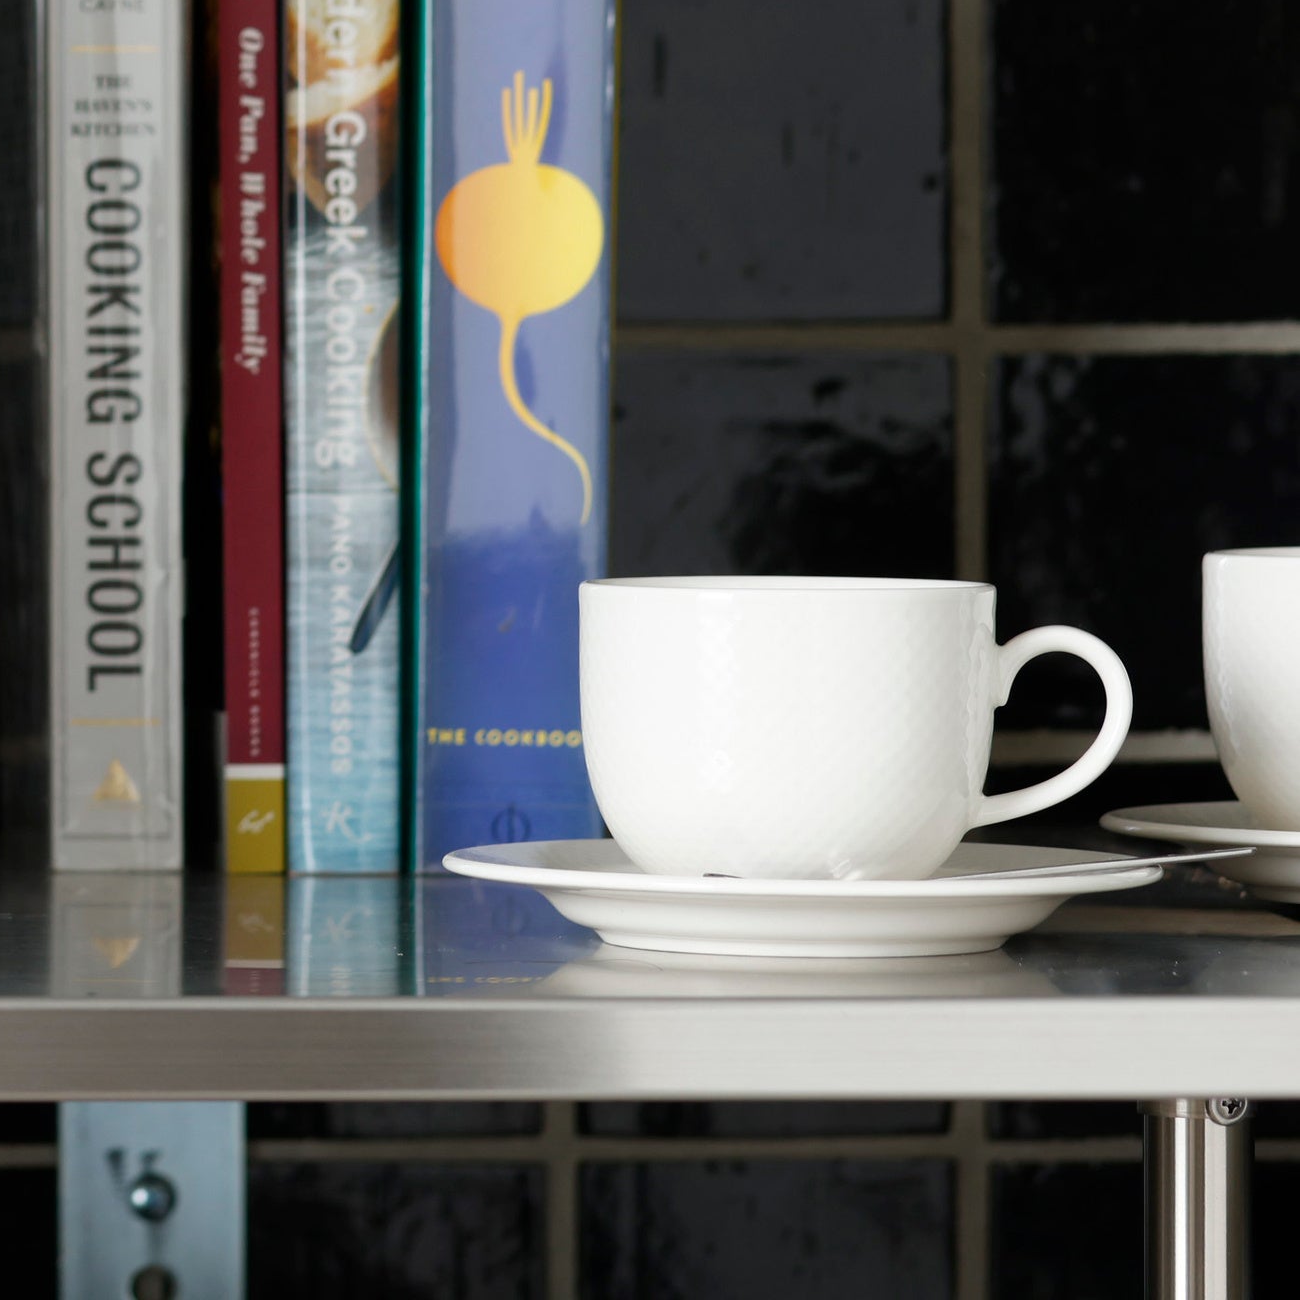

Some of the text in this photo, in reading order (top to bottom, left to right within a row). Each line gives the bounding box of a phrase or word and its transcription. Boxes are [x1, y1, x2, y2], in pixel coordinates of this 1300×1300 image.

[238, 27, 264, 89] One
[238, 95, 264, 165] Pan,
[240, 172, 266, 265] Whole
[325, 110, 368, 255] Greek
[234, 272, 268, 375] Family
[314, 267, 368, 470] Cooking
[85, 157, 143, 693] COOKING SCHOOL
[331, 584, 352, 775] KARATASSOS
[427, 728, 582, 748] THE COOKBOO
